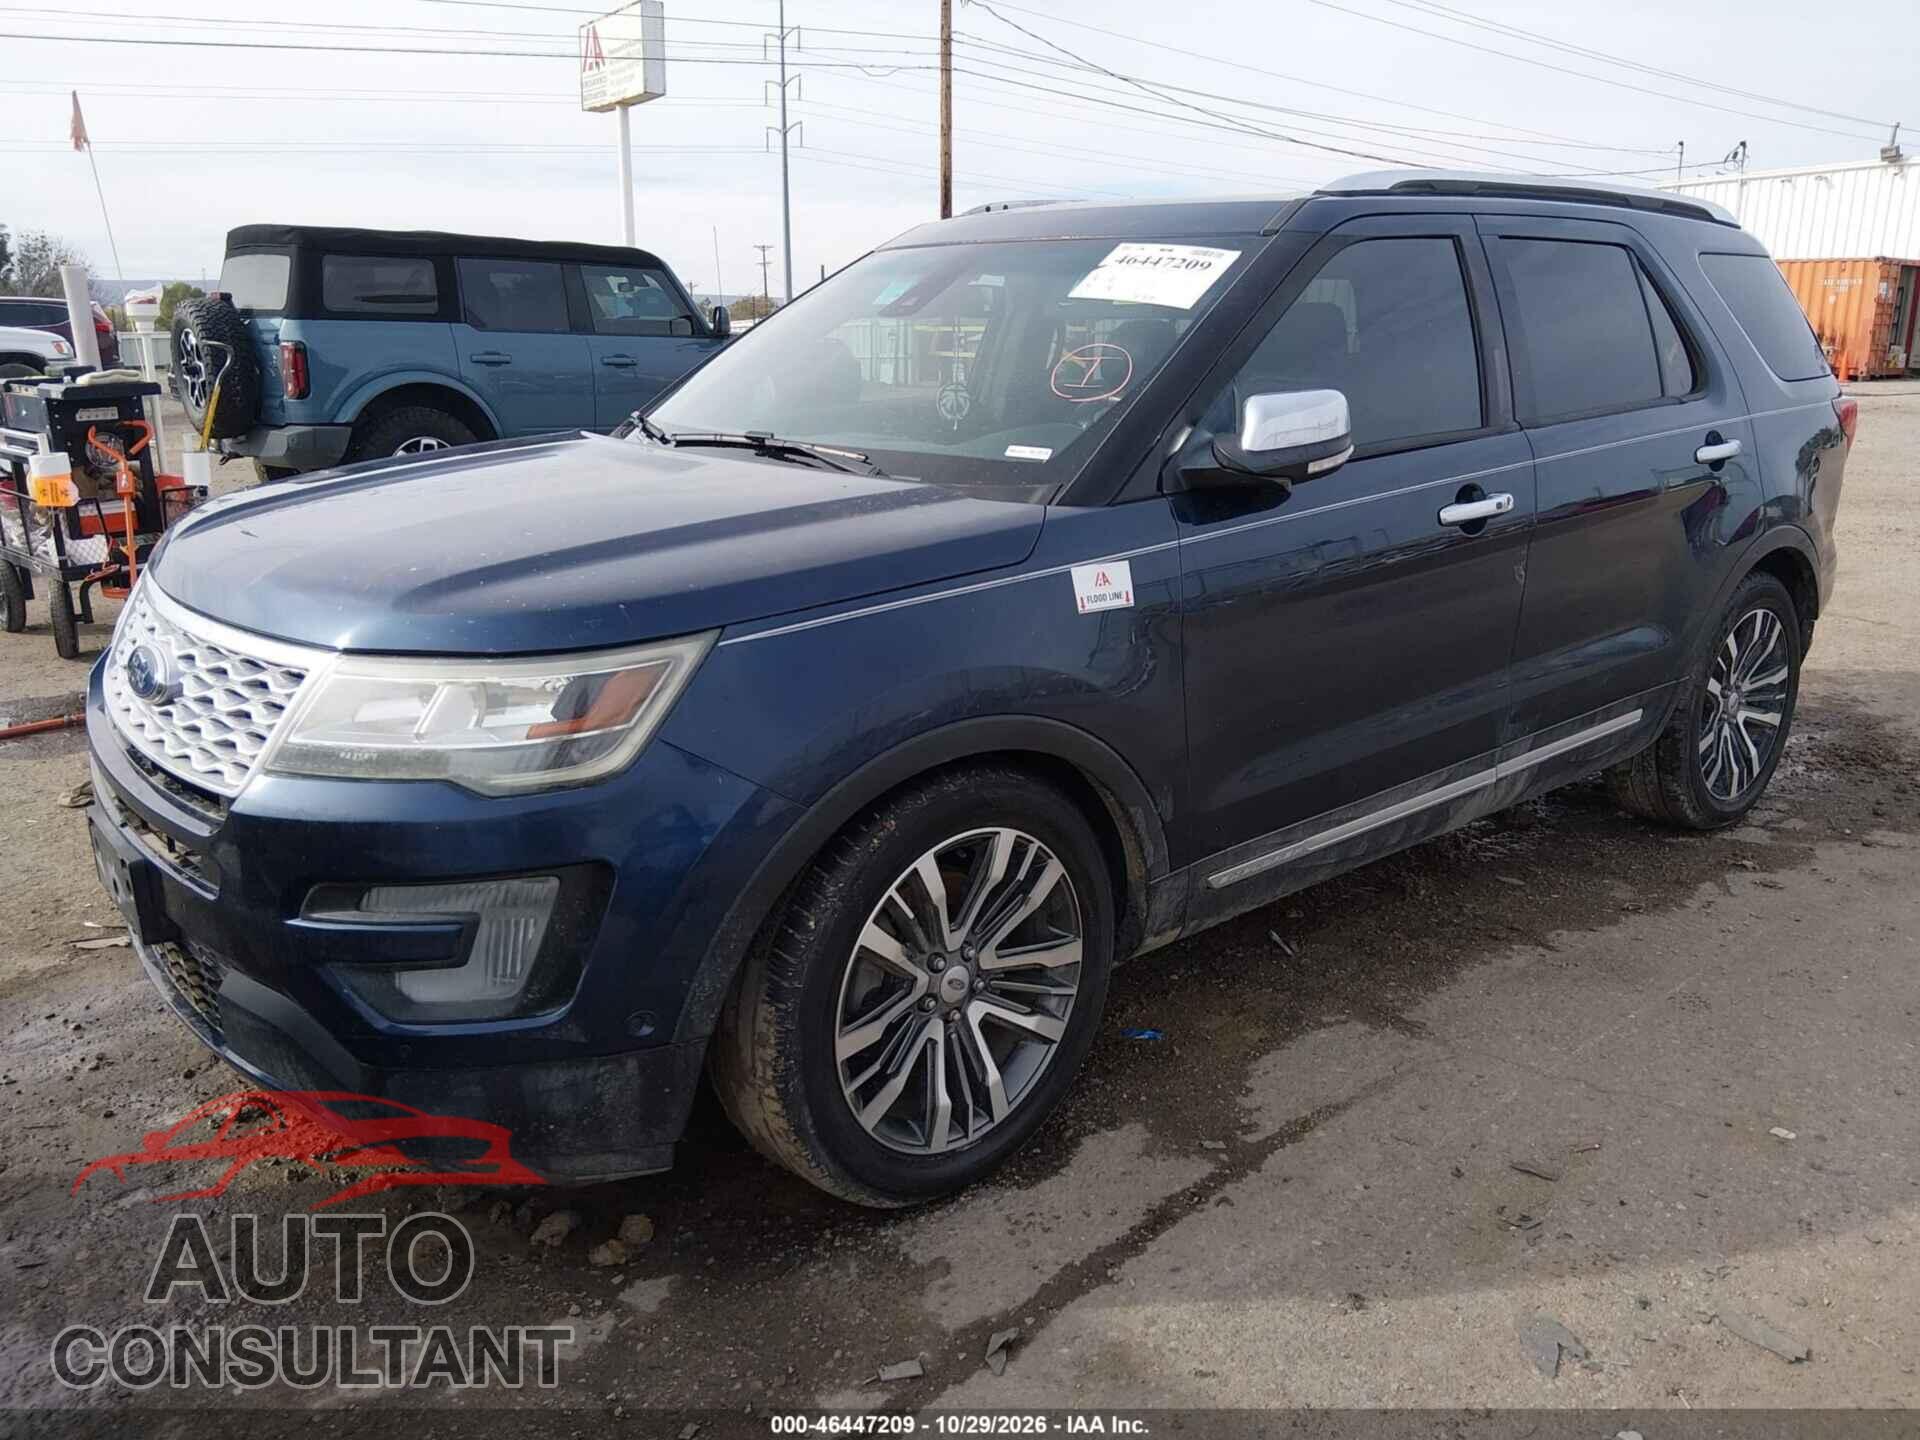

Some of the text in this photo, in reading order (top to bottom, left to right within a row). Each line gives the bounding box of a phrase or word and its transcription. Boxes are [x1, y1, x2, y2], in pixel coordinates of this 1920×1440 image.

[1115, 255, 1213, 271] 46447209
[1087, 591, 1123, 604] FLOOD LINE
